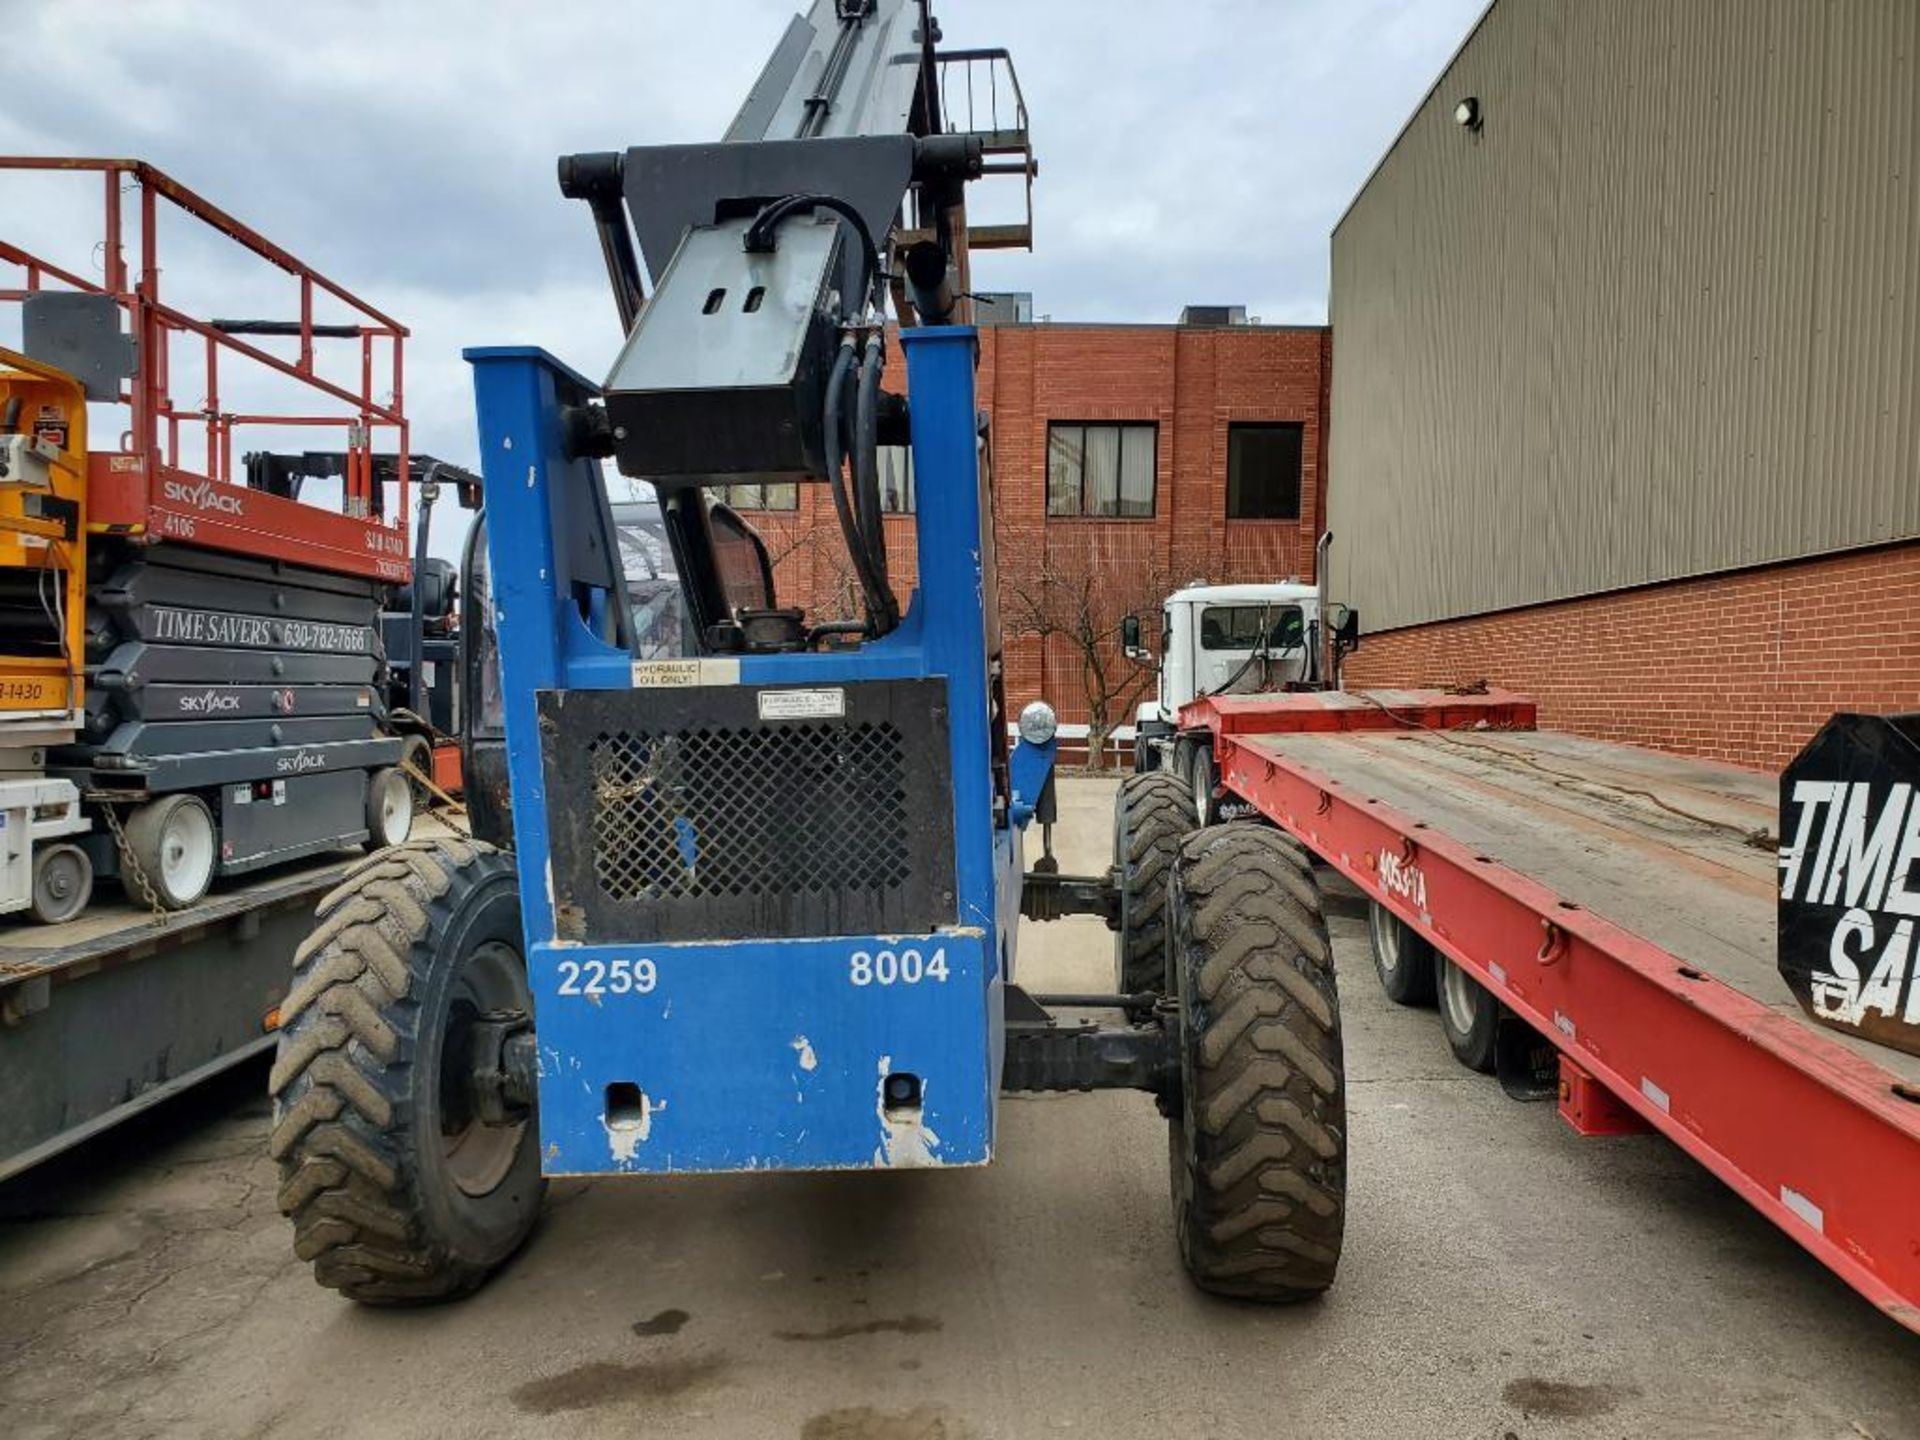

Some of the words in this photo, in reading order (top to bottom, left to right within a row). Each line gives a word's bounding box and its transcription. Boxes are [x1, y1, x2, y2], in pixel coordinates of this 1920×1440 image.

[164, 480, 244, 516] SKYJACK
[155, 609, 205, 640] TIME
[207, 614, 271, 645] SAVERS
[635, 663, 697, 675] HYDRAULIC
[179, 689, 240, 713] SKYJACK
[276, 749, 326, 772] SKYJACK
[557, 959, 657, 996] 2259
[850, 948, 949, 986] 8004
